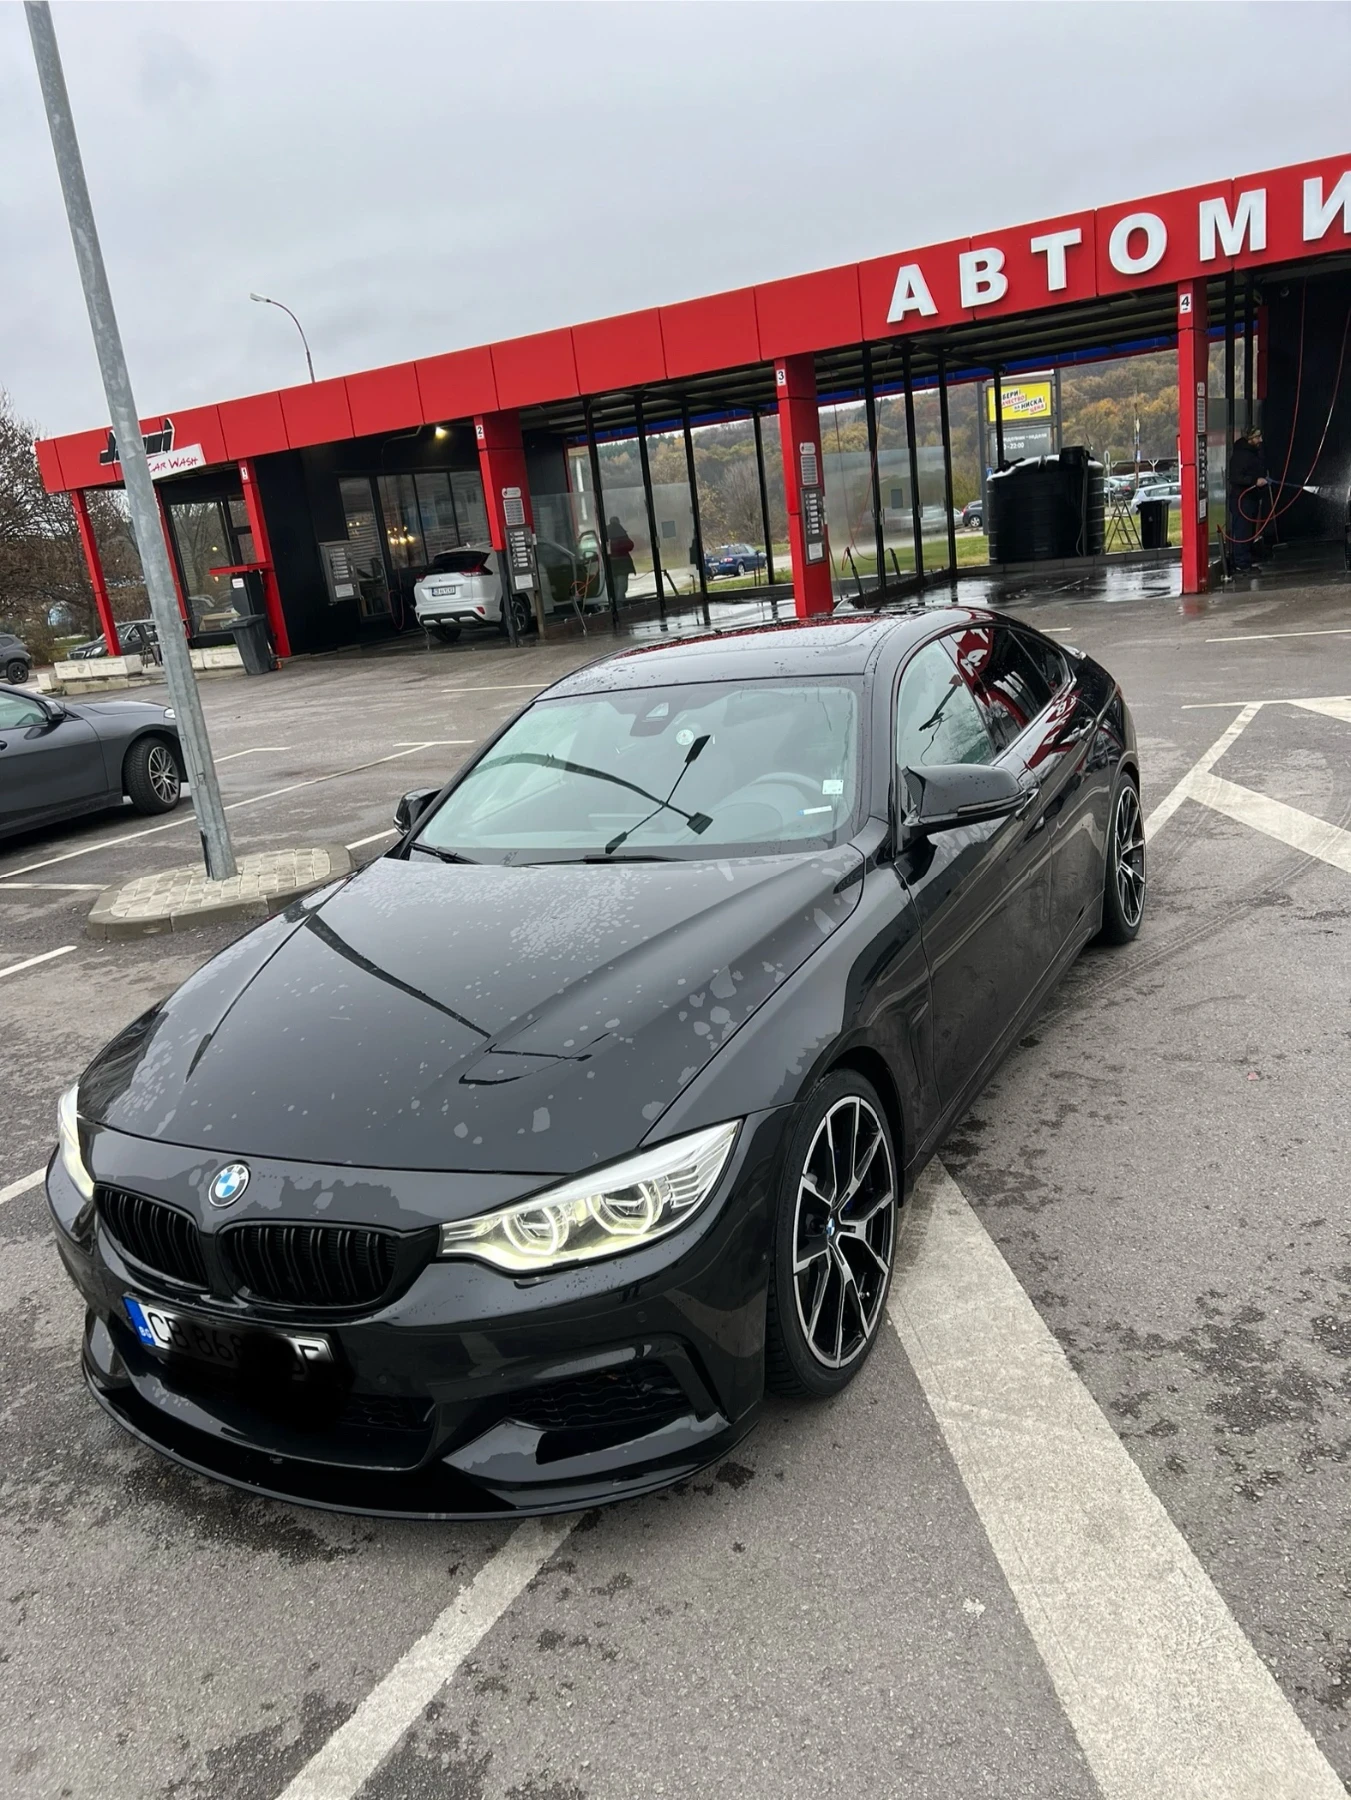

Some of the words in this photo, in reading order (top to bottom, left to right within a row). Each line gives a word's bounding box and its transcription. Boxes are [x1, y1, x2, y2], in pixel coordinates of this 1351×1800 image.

[886, 170, 1351, 324] АВТОМИ
[1181, 295, 1190, 307] 4
[778, 370, 784, 381] 3
[1021, 398, 1042, 409] НИСКА
[477, 426, 483, 435] 2
[168, 457, 198, 469] WASH
[138, 1325, 152, 1339] BG
